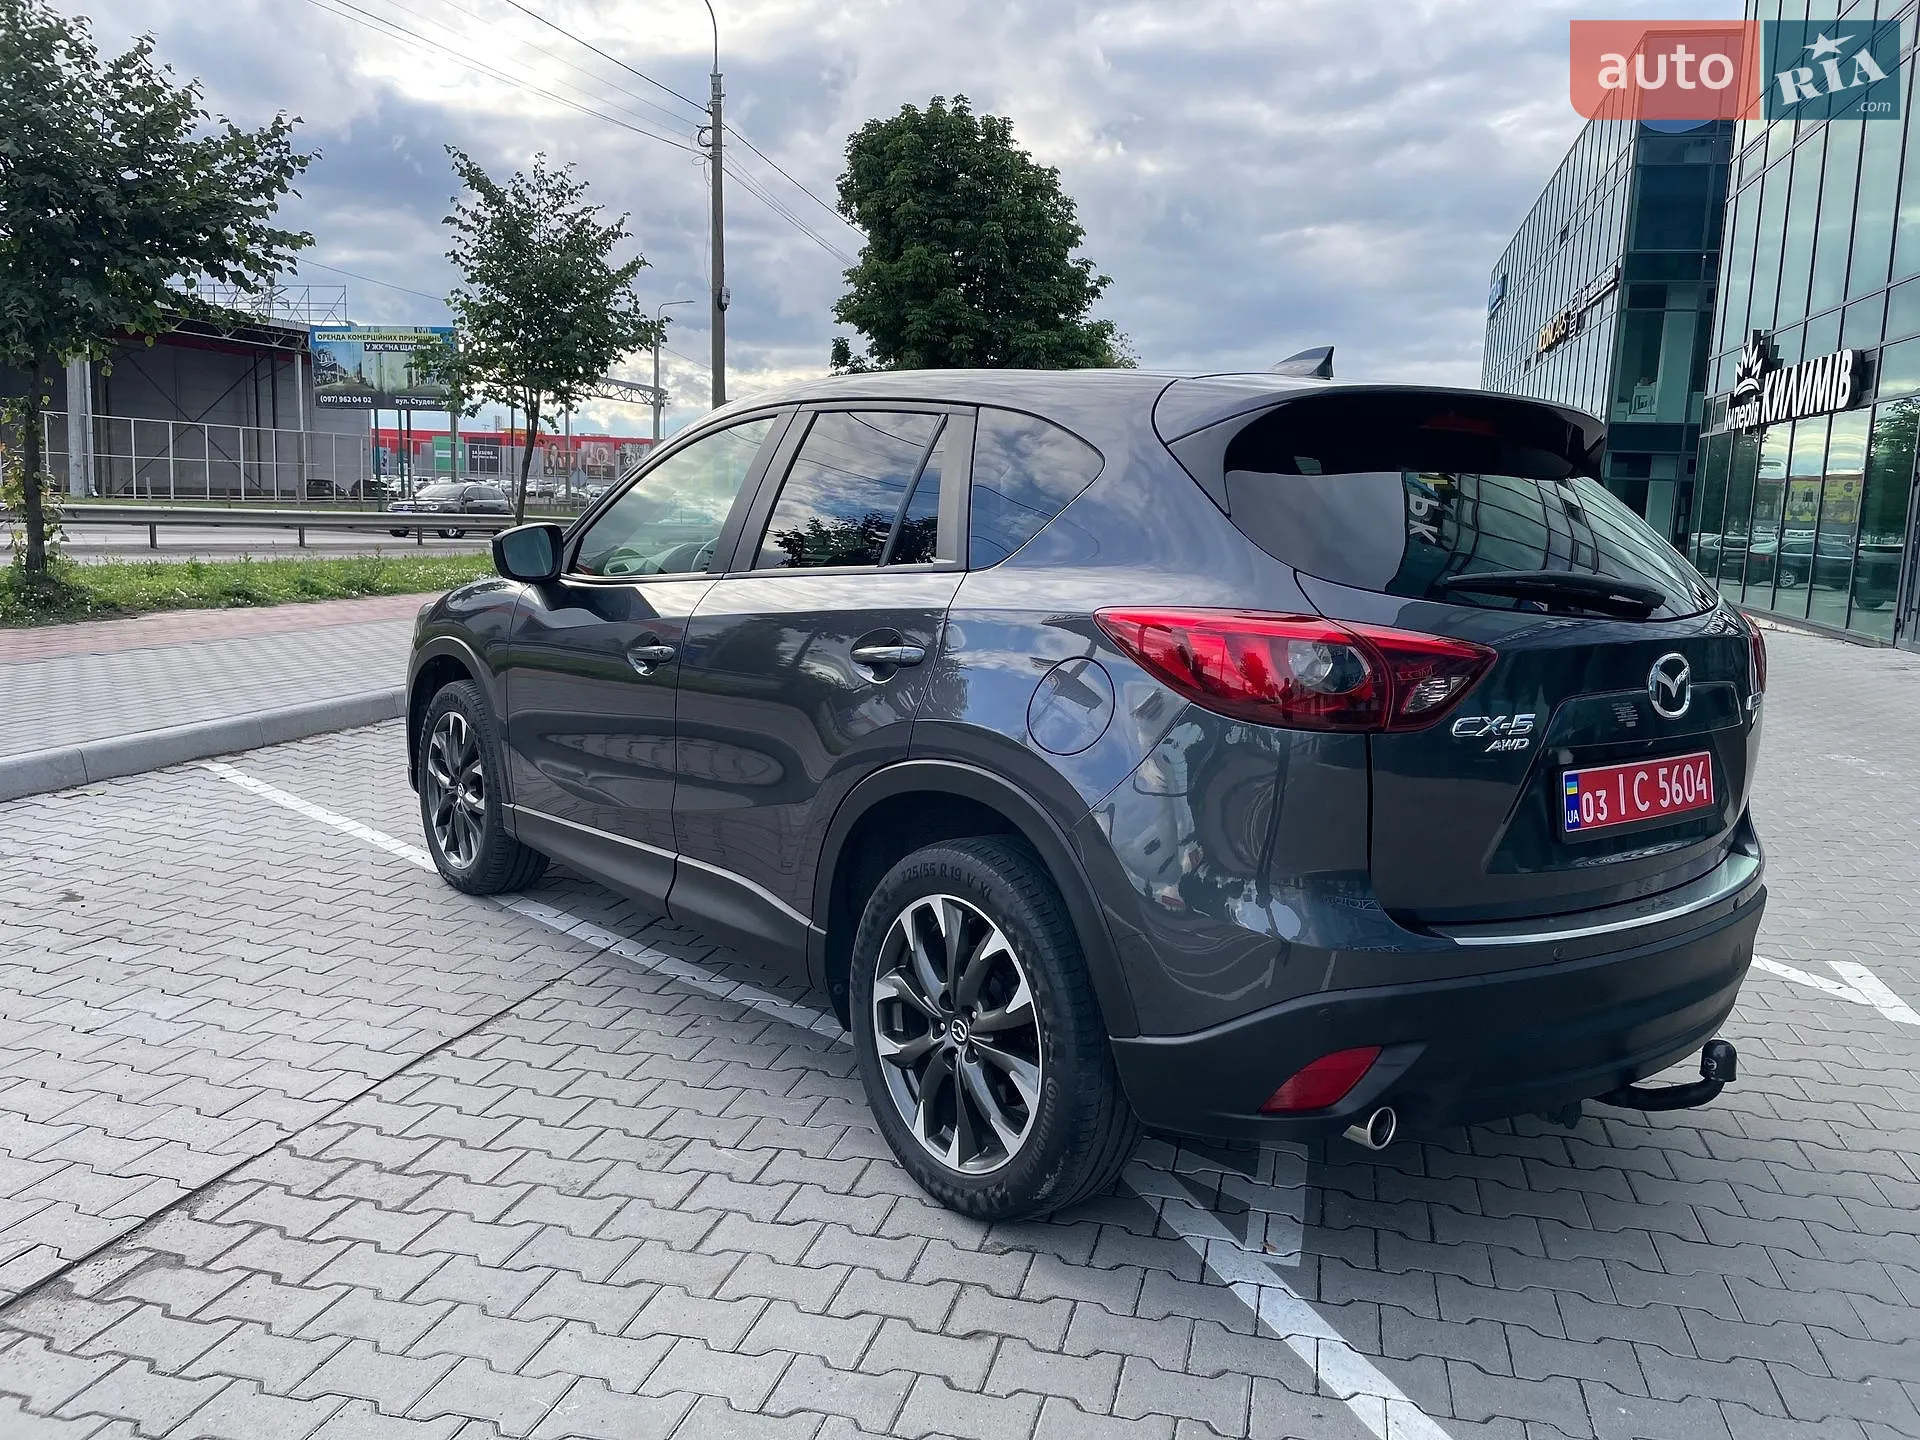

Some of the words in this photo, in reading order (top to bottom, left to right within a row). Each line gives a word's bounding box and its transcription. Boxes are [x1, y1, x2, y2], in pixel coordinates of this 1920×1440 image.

[317, 334, 346, 342] ОРЕНДА
[347, 333, 397, 342] КОМЕРЦІЙНИХ
[320, 394, 338, 404] (097)
[1724, 393, 1760, 435] Імперія
[1761, 348, 1853, 424] КИЛИМІВ
[395, 398, 410, 406] вул.
[1450, 713, 1537, 739] CX-5
[1484, 738, 1530, 754] AWD
[1581, 789, 1609, 824] 03
[1658, 760, 1709, 809] 5604
[1567, 808, 1580, 824] UA
